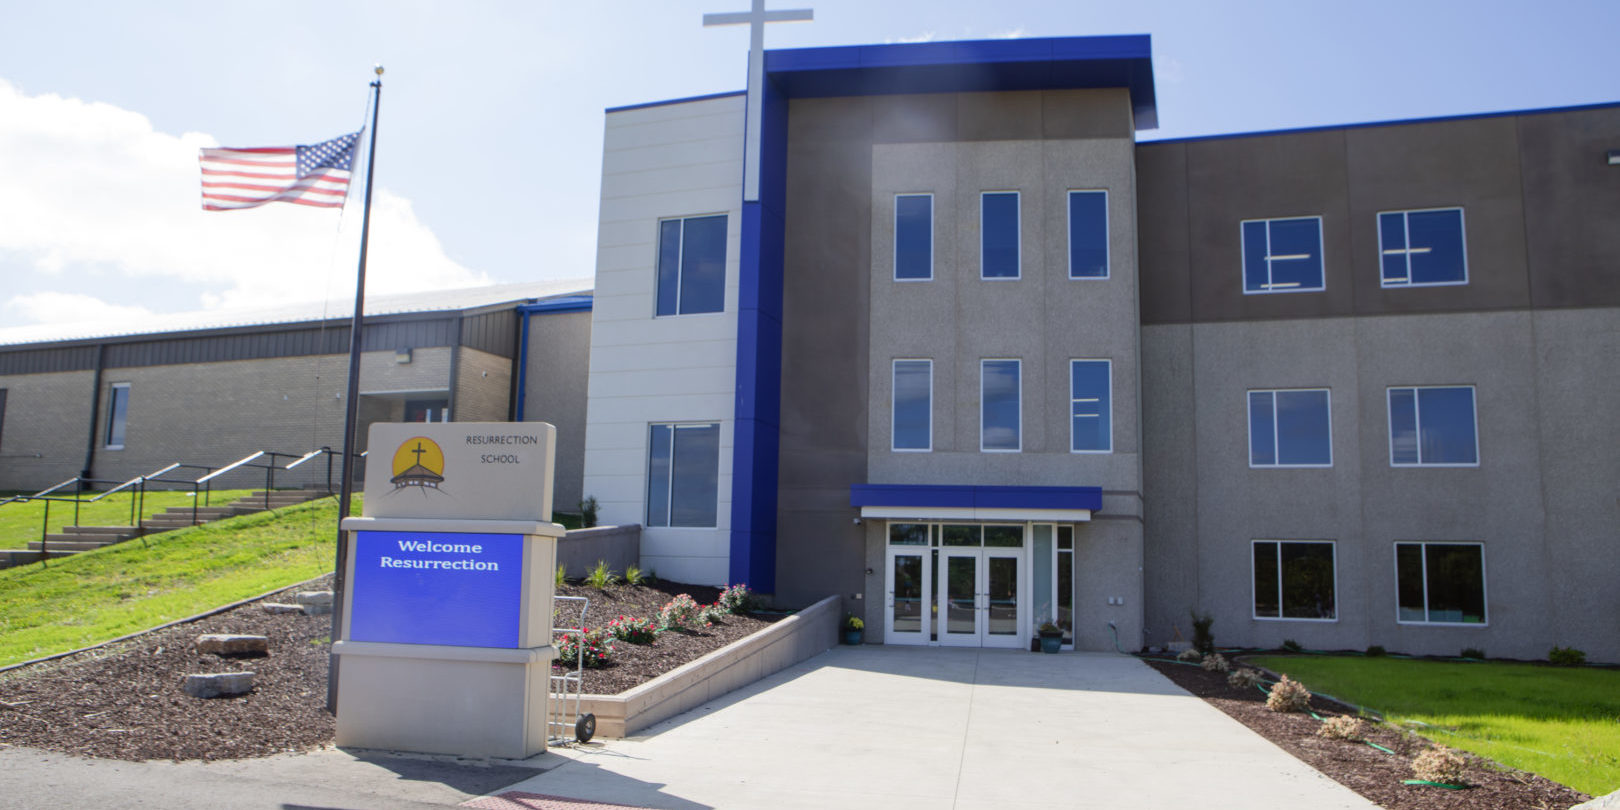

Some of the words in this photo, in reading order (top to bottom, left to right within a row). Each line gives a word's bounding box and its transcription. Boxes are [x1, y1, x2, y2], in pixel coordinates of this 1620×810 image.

[466, 435, 538, 445] RESURRECTION
[480, 454, 520, 464] SCHOOL
[398, 540, 482, 553] Welcome
[380, 556, 499, 571] Resurrection
